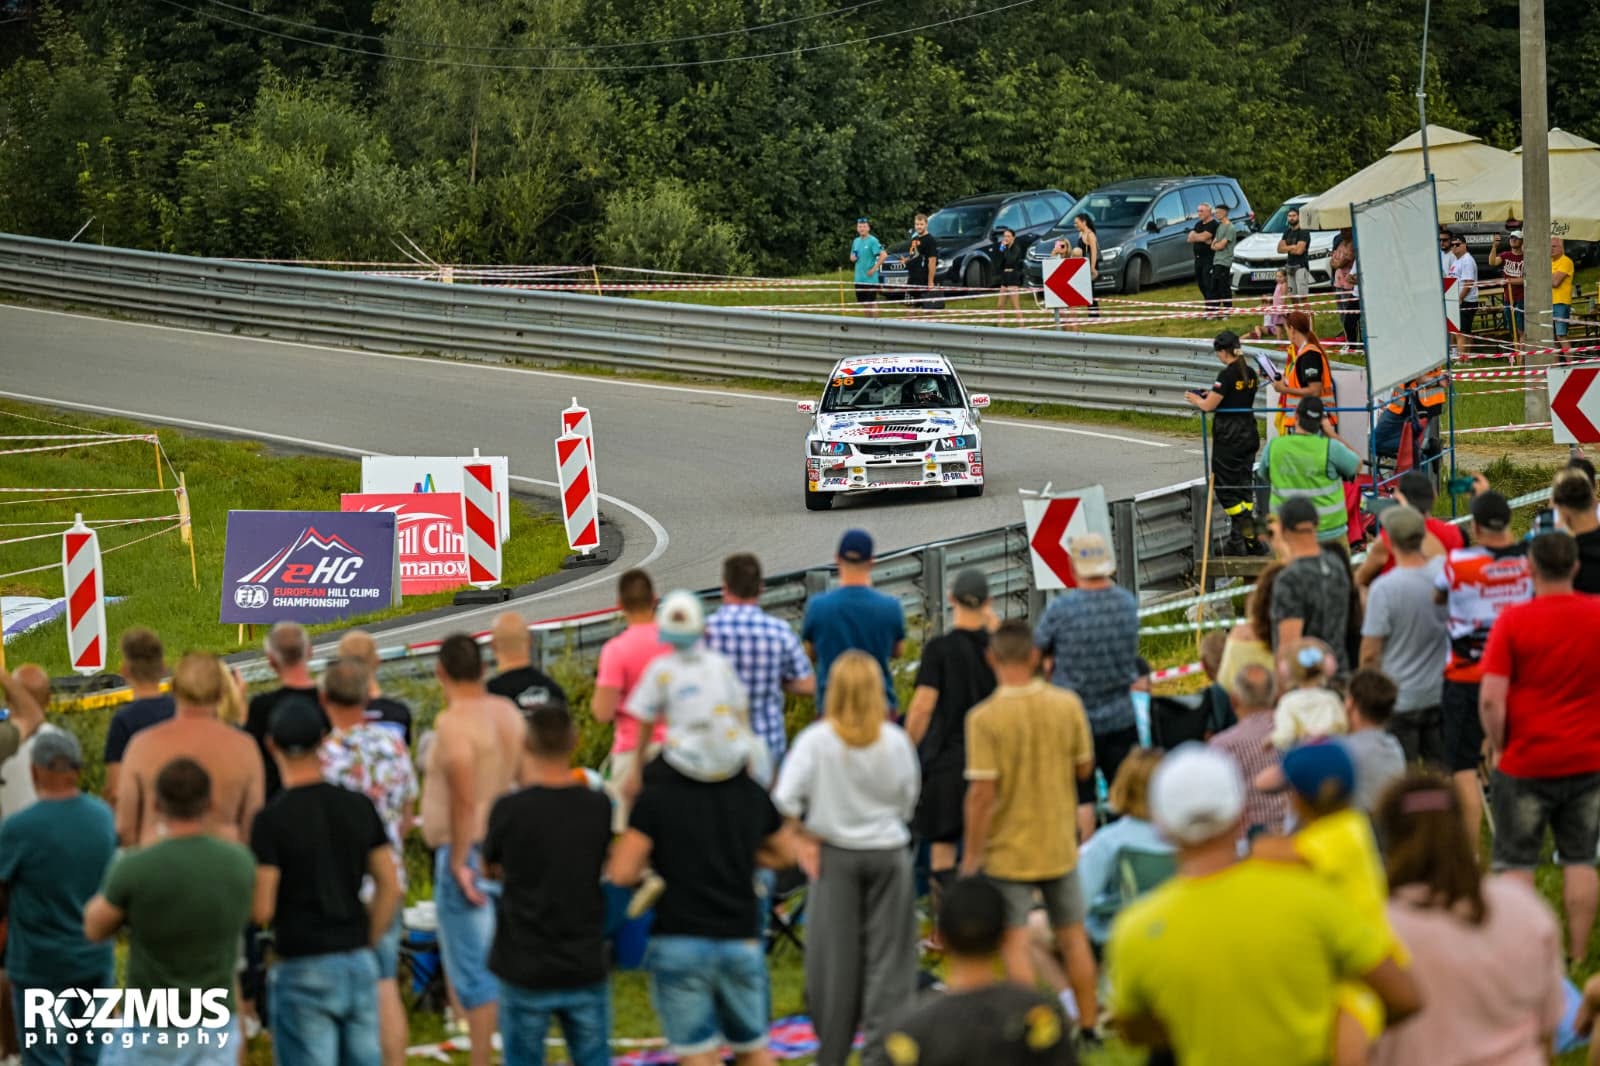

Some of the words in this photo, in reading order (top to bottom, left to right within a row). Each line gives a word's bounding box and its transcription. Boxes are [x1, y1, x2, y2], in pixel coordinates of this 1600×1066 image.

[1455, 210, 1482, 222] OKOCIM
[872, 366, 943, 374] Valvoline
[832, 377, 855, 388] 36
[281, 557, 364, 584] eHC
[273, 587, 326, 597] EUROPEAN
[327, 588, 348, 598] HILL
[350, 588, 380, 598] CLIMB
[272, 598, 350, 608] CHAMPIONSHIP
